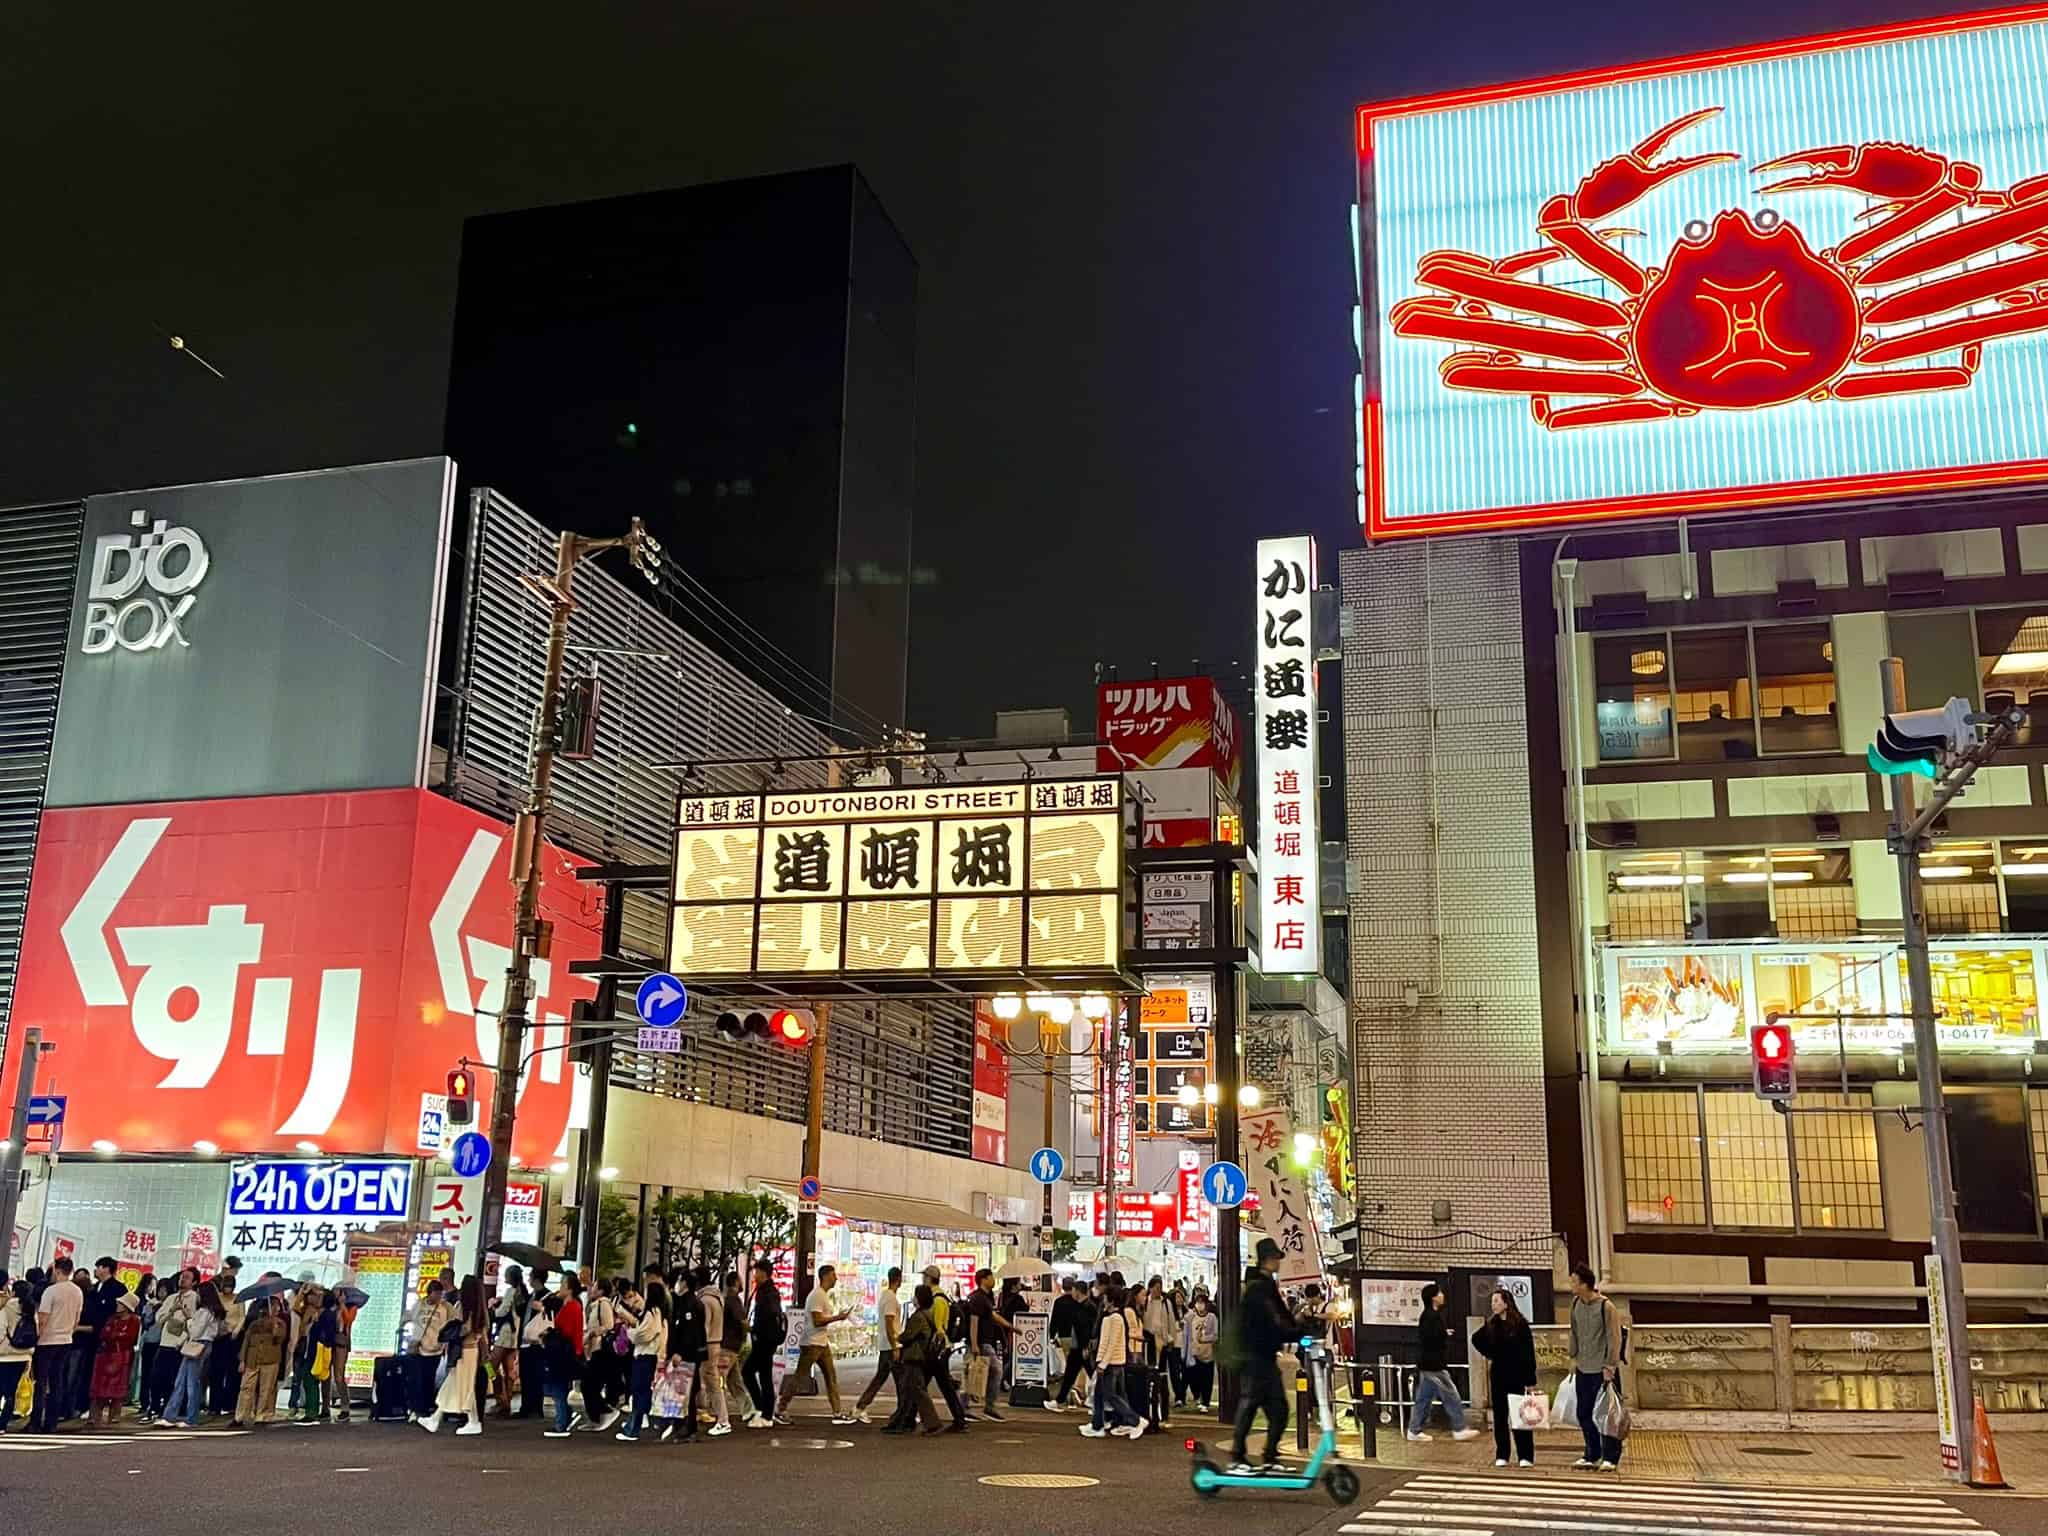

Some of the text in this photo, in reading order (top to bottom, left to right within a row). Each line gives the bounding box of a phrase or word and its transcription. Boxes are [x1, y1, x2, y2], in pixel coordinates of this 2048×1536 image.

[81, 593, 197, 654] BOX
[1105, 685, 1192, 715] ツルハ
[1105, 716, 1173, 738] ドラッグ
[684, 798, 756, 823] 道頓堀
[771, 790, 1019, 816] DOUTONBORI STREET
[1035, 783, 1114, 808] 道頓堀
[773, 822, 1013, 893] 道頓堀
[1273, 769, 1305, 951] 道頓堀 東店
[60, 817, 362, 1136] くすり
[233, 1167, 408, 1212] 24h OPEN
[123, 1228, 155, 1252] 免税
